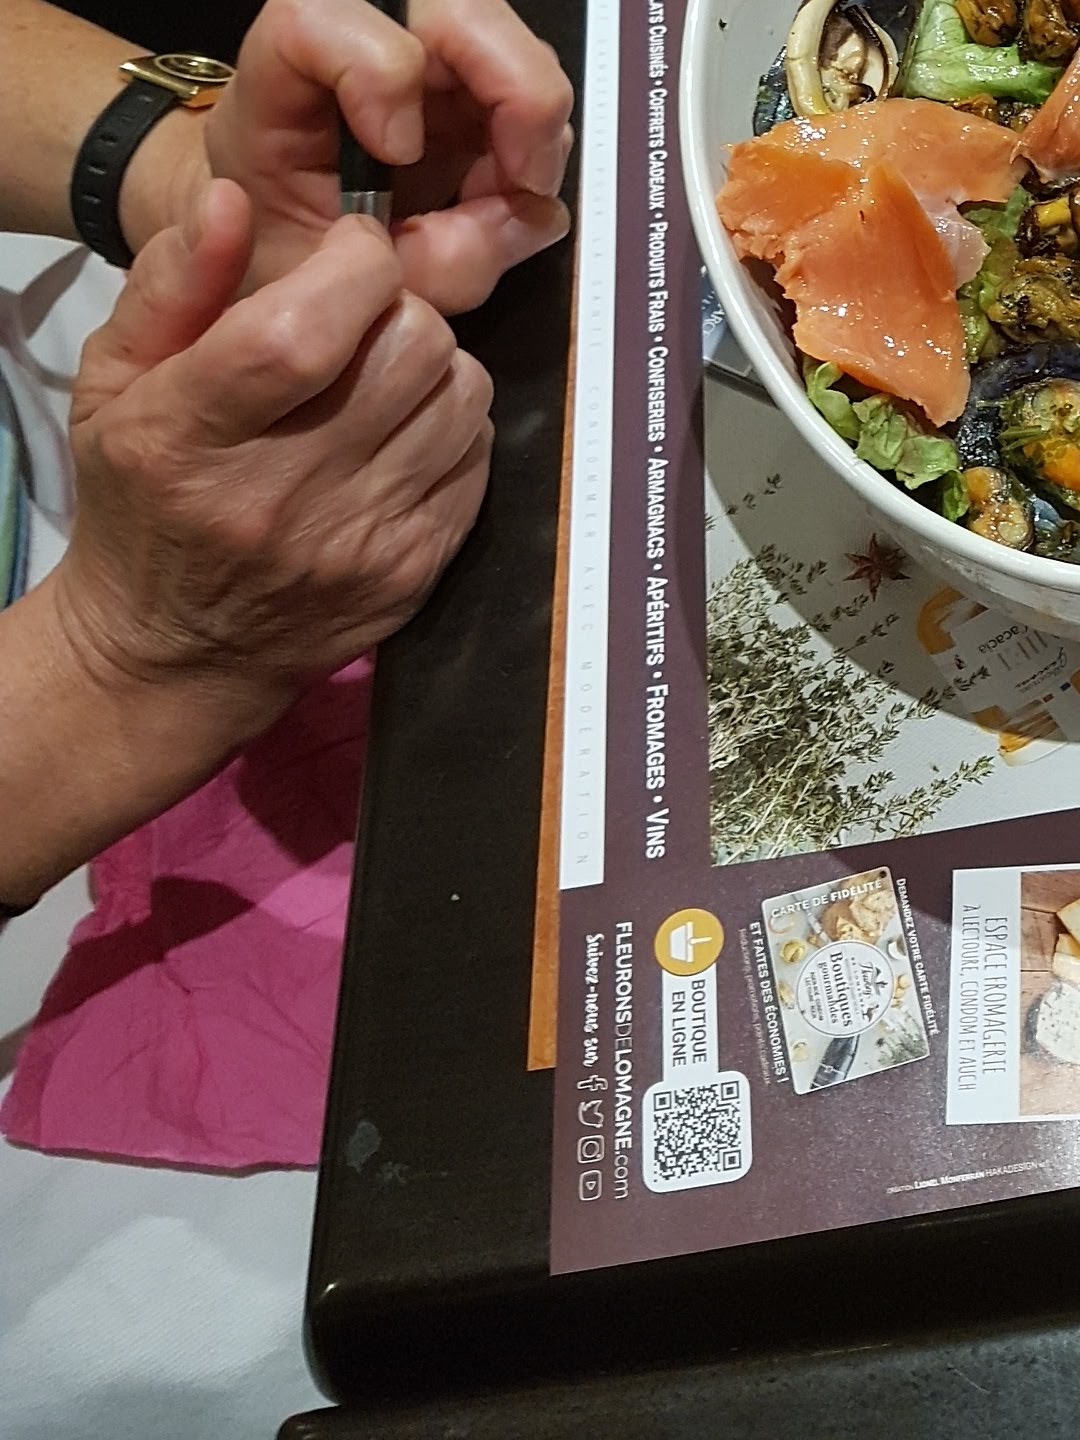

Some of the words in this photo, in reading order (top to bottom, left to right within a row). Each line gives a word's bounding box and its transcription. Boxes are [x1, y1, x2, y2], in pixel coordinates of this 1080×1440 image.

[649, 88, 668, 146] COFFRETS
[649, 150, 668, 210] CADEAUX
[649, 221, 668, 288] PRODUITS
[648, 291, 668, 333] FRAIS
[648, 346, 669, 442] CONFISERIES
[647, 458, 669, 559] ARMAGNACS
[646, 576, 669, 665] APÉRITIFS
[646, 684, 669, 789] FROMAGES
[646, 808, 669, 859] VINS
[749, 921, 761, 935] ET
[771, 899, 810, 918] CARTE
[812, 894, 829, 907] DE
[896, 878, 915, 929] DEMANDEZ
[752, 938, 770, 978] FAITES
[906, 930, 922, 962] VOTRE
[983, 917, 1008, 970] ESPACE
[583, 932, 604, 1033] Suivez-nous
[672, 991, 686, 1012] EN
[760, 980, 774, 1003] DES
[818, 962, 840, 1024] gourmandes
[830, 951, 853, 1027] Boutiques
[914, 962, 931, 996] CARTE
[691, 978, 708, 1065] BOUTIQUE
[922, 996, 941, 1036] FIDÉLITÉ
[959, 980, 979, 1035] CONDOM
[982, 976, 1008, 1075] FROMAGERIE
[582, 1038, 600, 1068] sur
[613, 921, 634, 1200] FLEURONSDELOMAGNE.com
[672, 1019, 687, 1068] LIGNE
[764, 1006, 787, 1076] ÉCONOMIES
[958, 1039, 976, 1051] ET
[958, 1056, 977, 1091] AUCH
